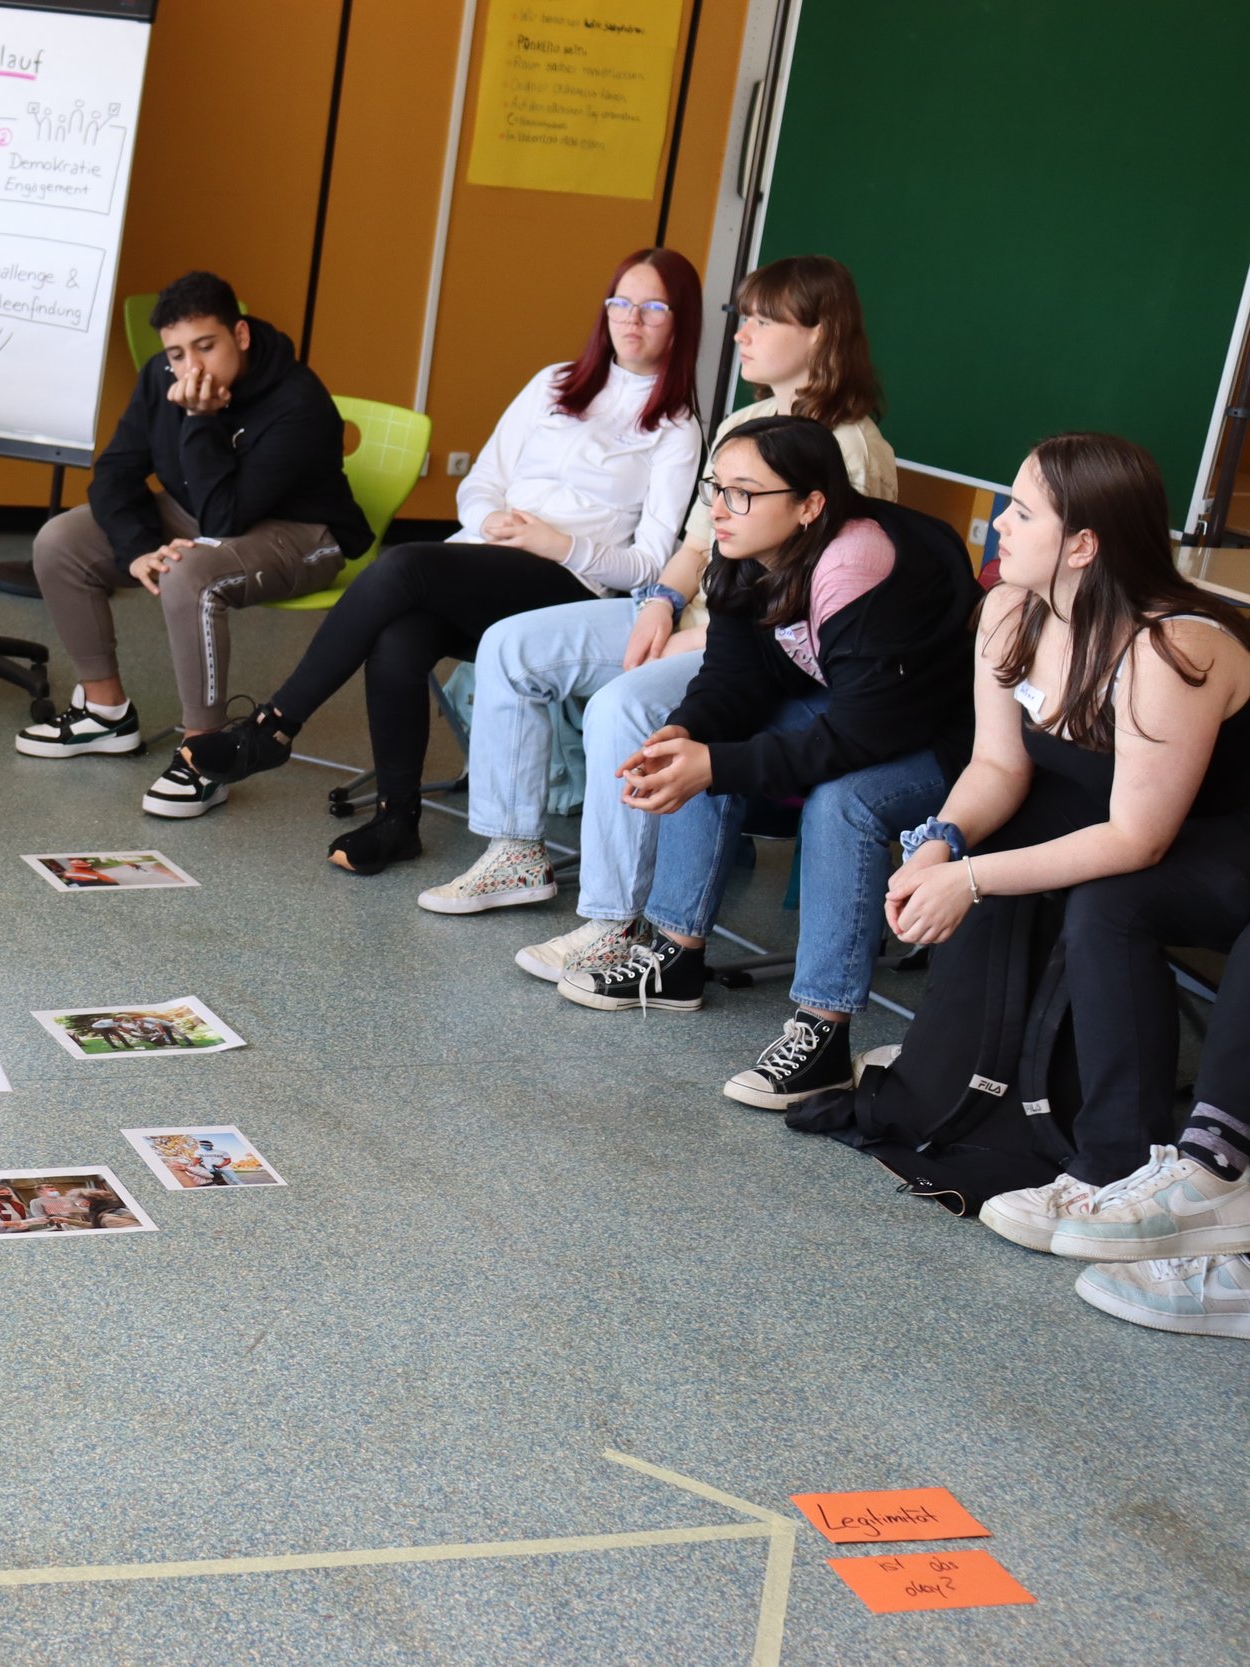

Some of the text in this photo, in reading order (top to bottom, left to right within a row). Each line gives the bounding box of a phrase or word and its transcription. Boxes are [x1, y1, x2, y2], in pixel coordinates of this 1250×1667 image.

[8, 151, 103, 178] Demokratie
[4, 175, 90, 200] Engagement
[66, 268, 81, 289] &
[978, 1079, 1002, 1095] FILA
[905, 1575, 956, 1600] okay?
